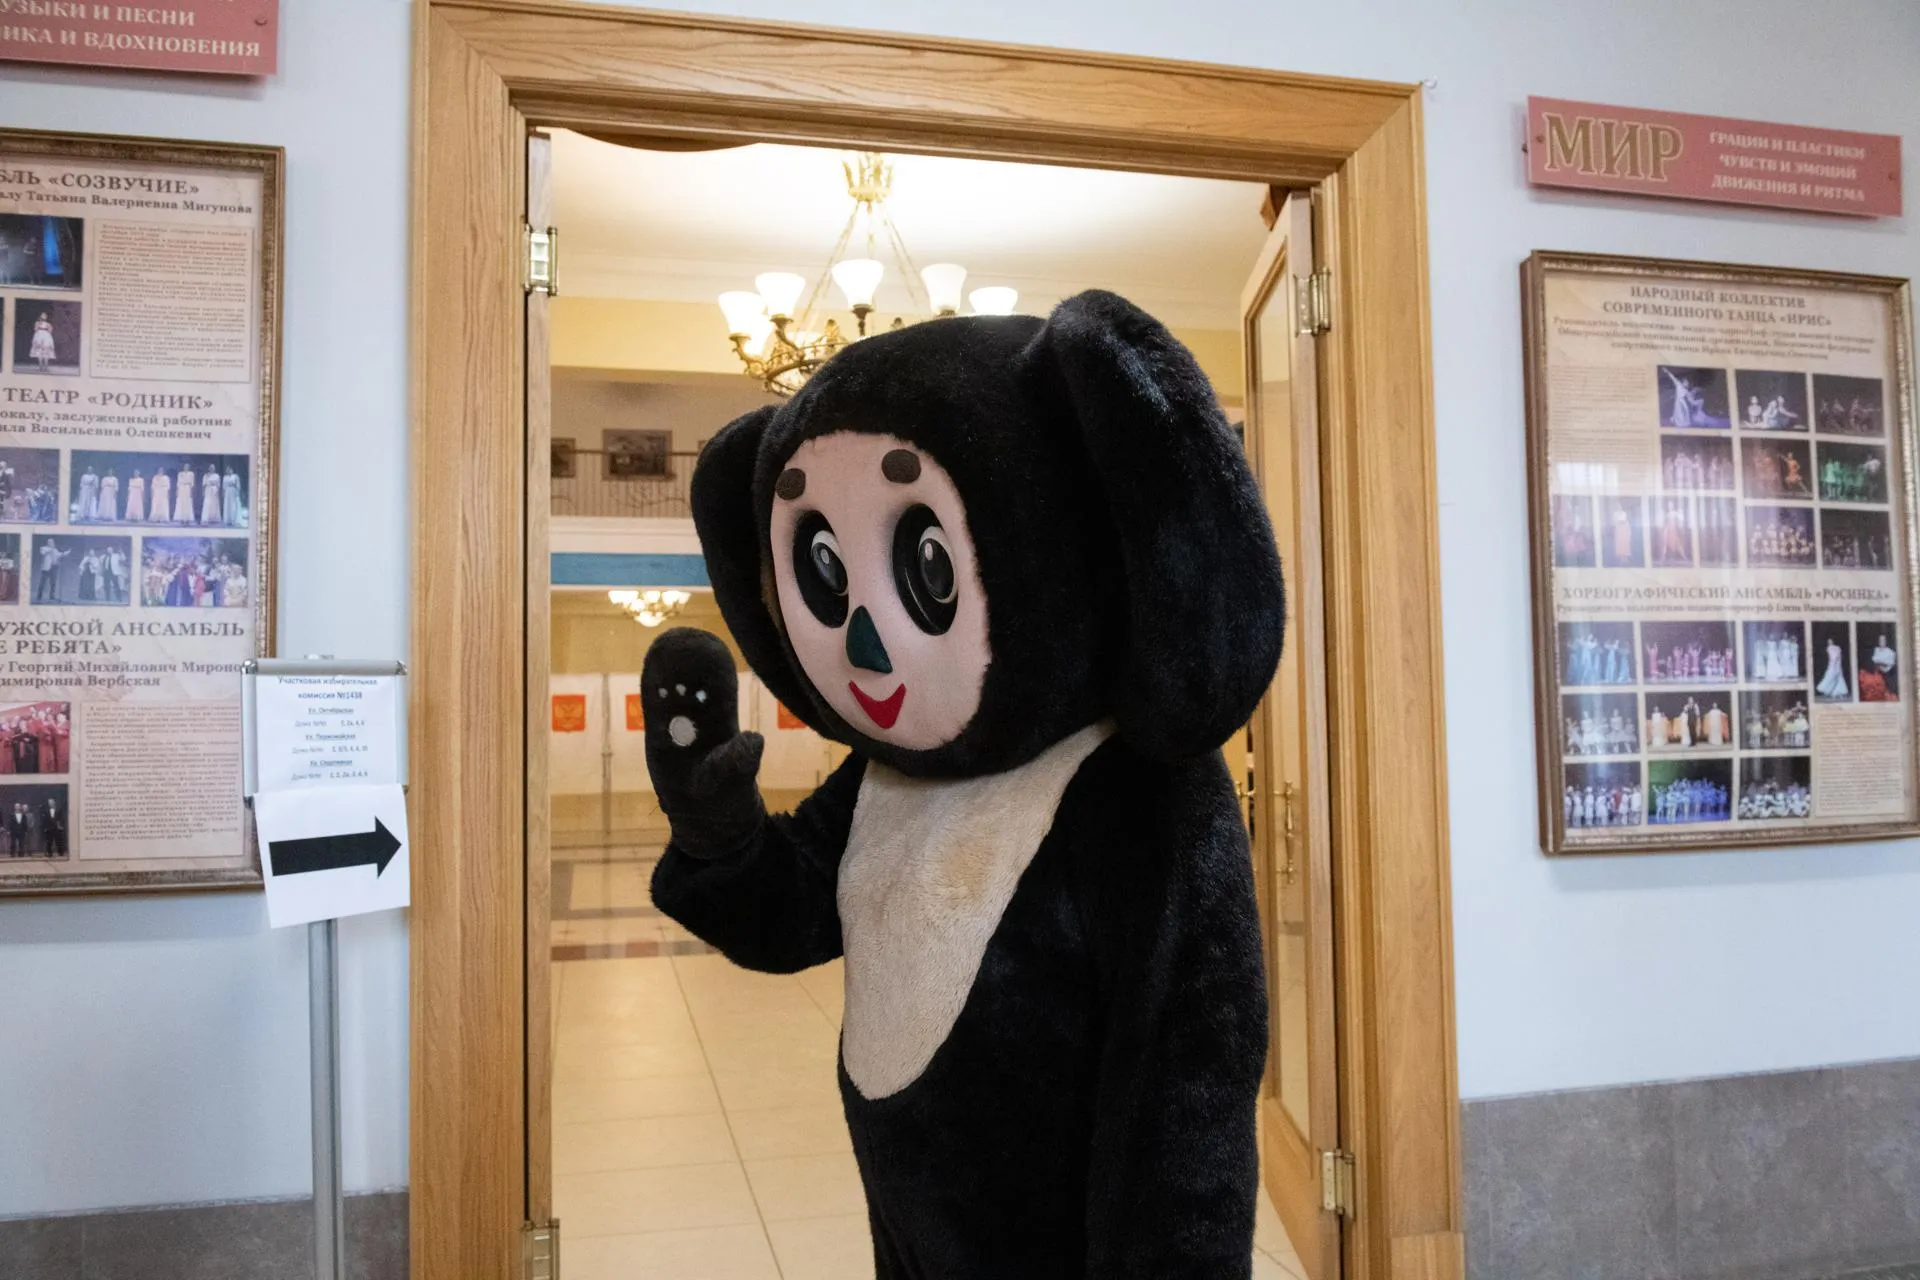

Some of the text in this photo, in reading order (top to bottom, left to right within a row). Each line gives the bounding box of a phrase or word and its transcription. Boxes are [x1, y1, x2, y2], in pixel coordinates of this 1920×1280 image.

[93, 5, 110, 20] И
[117, 6, 196, 26] ПЕСНИ
[61, 29, 77, 46] И
[84, 31, 260, 57] ВДОХНОВЕНИЯ
[1543, 112, 1684, 182] МИР
[1709, 132, 1865, 160] ГРАЦИИ И ПЛАСТИКИ
[1719, 154, 1857, 180] ЧУВСТВ И ЭМОЦИЙ
[48, 172, 199, 195] «СОЗВУЧИЕ»
[1711, 174, 1865, 202] ДВИЖЕНИЯ И РИТМА
[26, 190, 87, 204] Татьяна
[182, 200, 253, 214] Мигунова
[1630, 286, 1806, 309] НАРОДНЫЙ КОЛЛЕКТИВ
[1603, 301, 1832, 327] СОВРЕМЕННОГО ТАНЦА «ИРИС»
[3, 386, 213, 409] ТЕАТР «РОДНИК»
[31, 422, 122, 437] Васильевна
[53, 411, 159, 426] заслуженный
[163, 416, 232, 428] работник
[1563, 585, 1890, 601] ХОРЕОГРАФИЧЕСКИЙ АНСАМБЛЬ «РОСИНКА»
[112, 620, 245, 637] АНСАМБЛЬ
[15, 640, 123, 655] РЕБЯТА»
[8, 660, 74, 675] Георгий
[78, 660, 177, 674] Михайлович
[182, 661, 242, 676] Мироно
[87, 674, 161, 689] Вербская
